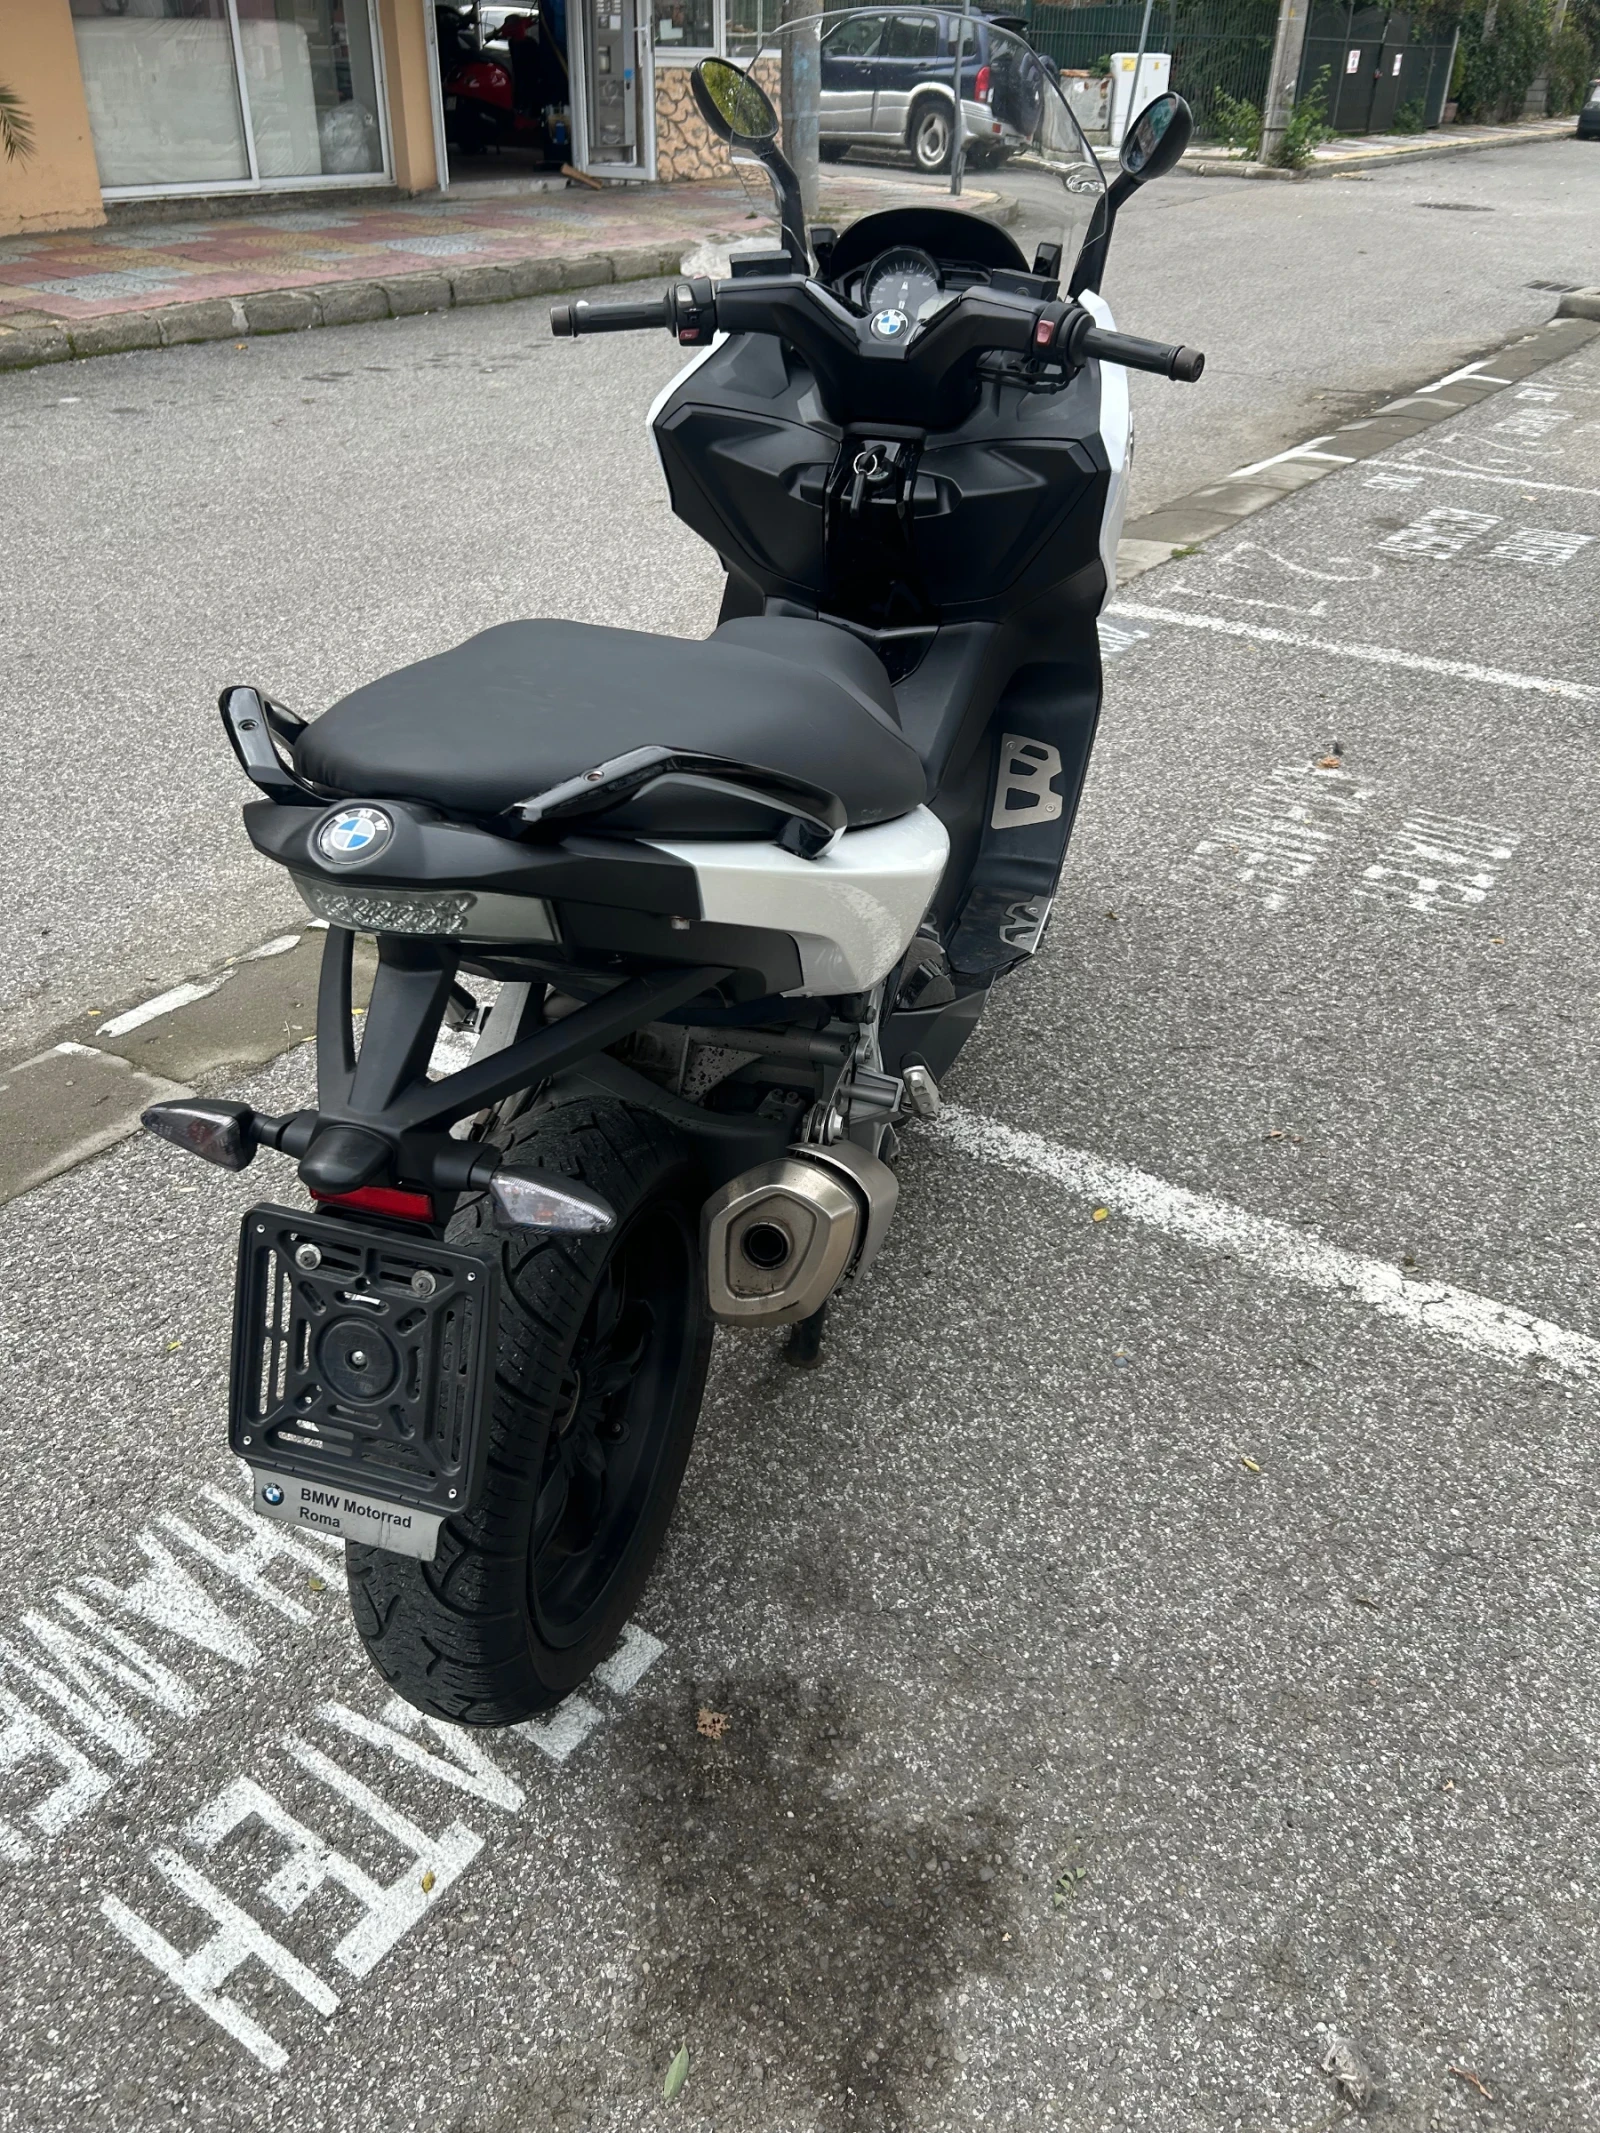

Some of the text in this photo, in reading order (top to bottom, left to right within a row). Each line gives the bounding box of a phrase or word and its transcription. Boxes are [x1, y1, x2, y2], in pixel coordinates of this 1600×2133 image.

[299, 1507, 341, 1529] Roma
[300, 1487, 412, 1529] BMW Motorrad
